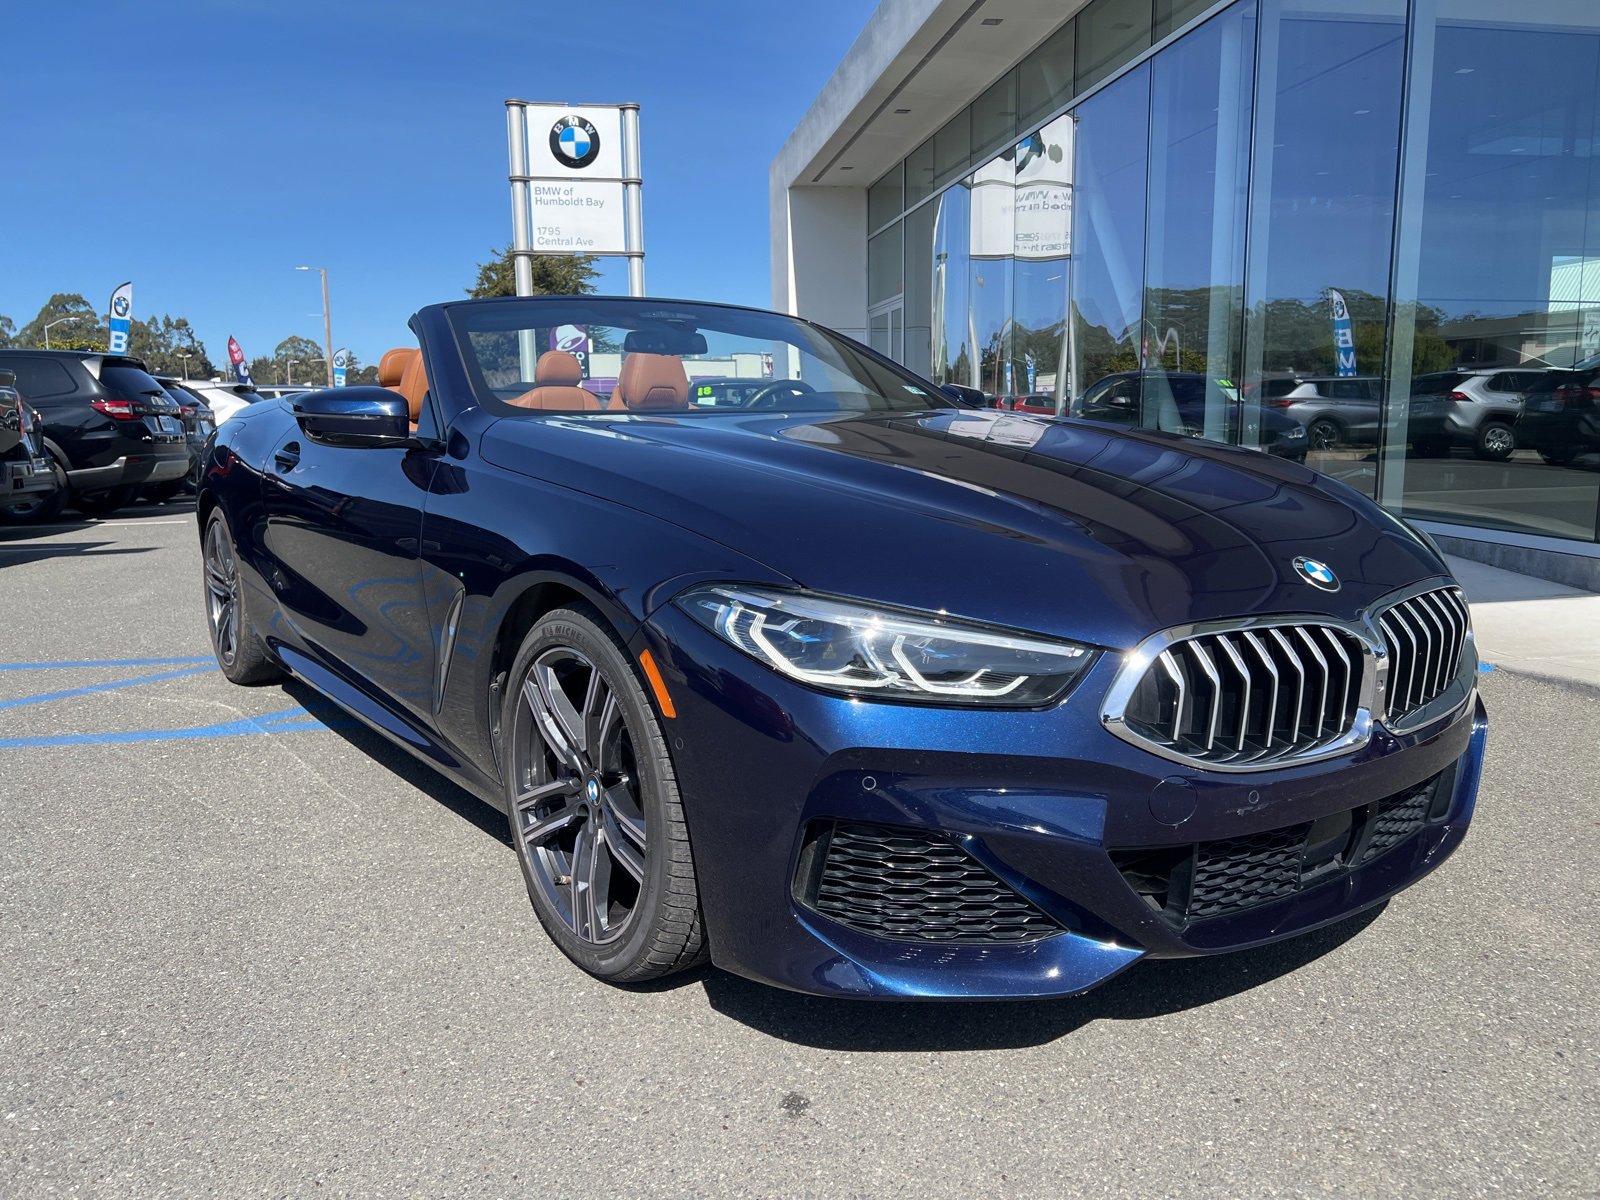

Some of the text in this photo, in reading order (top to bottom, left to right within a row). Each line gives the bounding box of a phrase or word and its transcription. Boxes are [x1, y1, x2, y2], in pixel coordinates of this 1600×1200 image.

[553, 116, 596, 135] BMW
[534, 186, 575, 196] BMW of
[535, 197, 605, 208] Humboldt Bay
[537, 227, 561, 236] 1795
[537, 236, 594, 246] Central Ave
